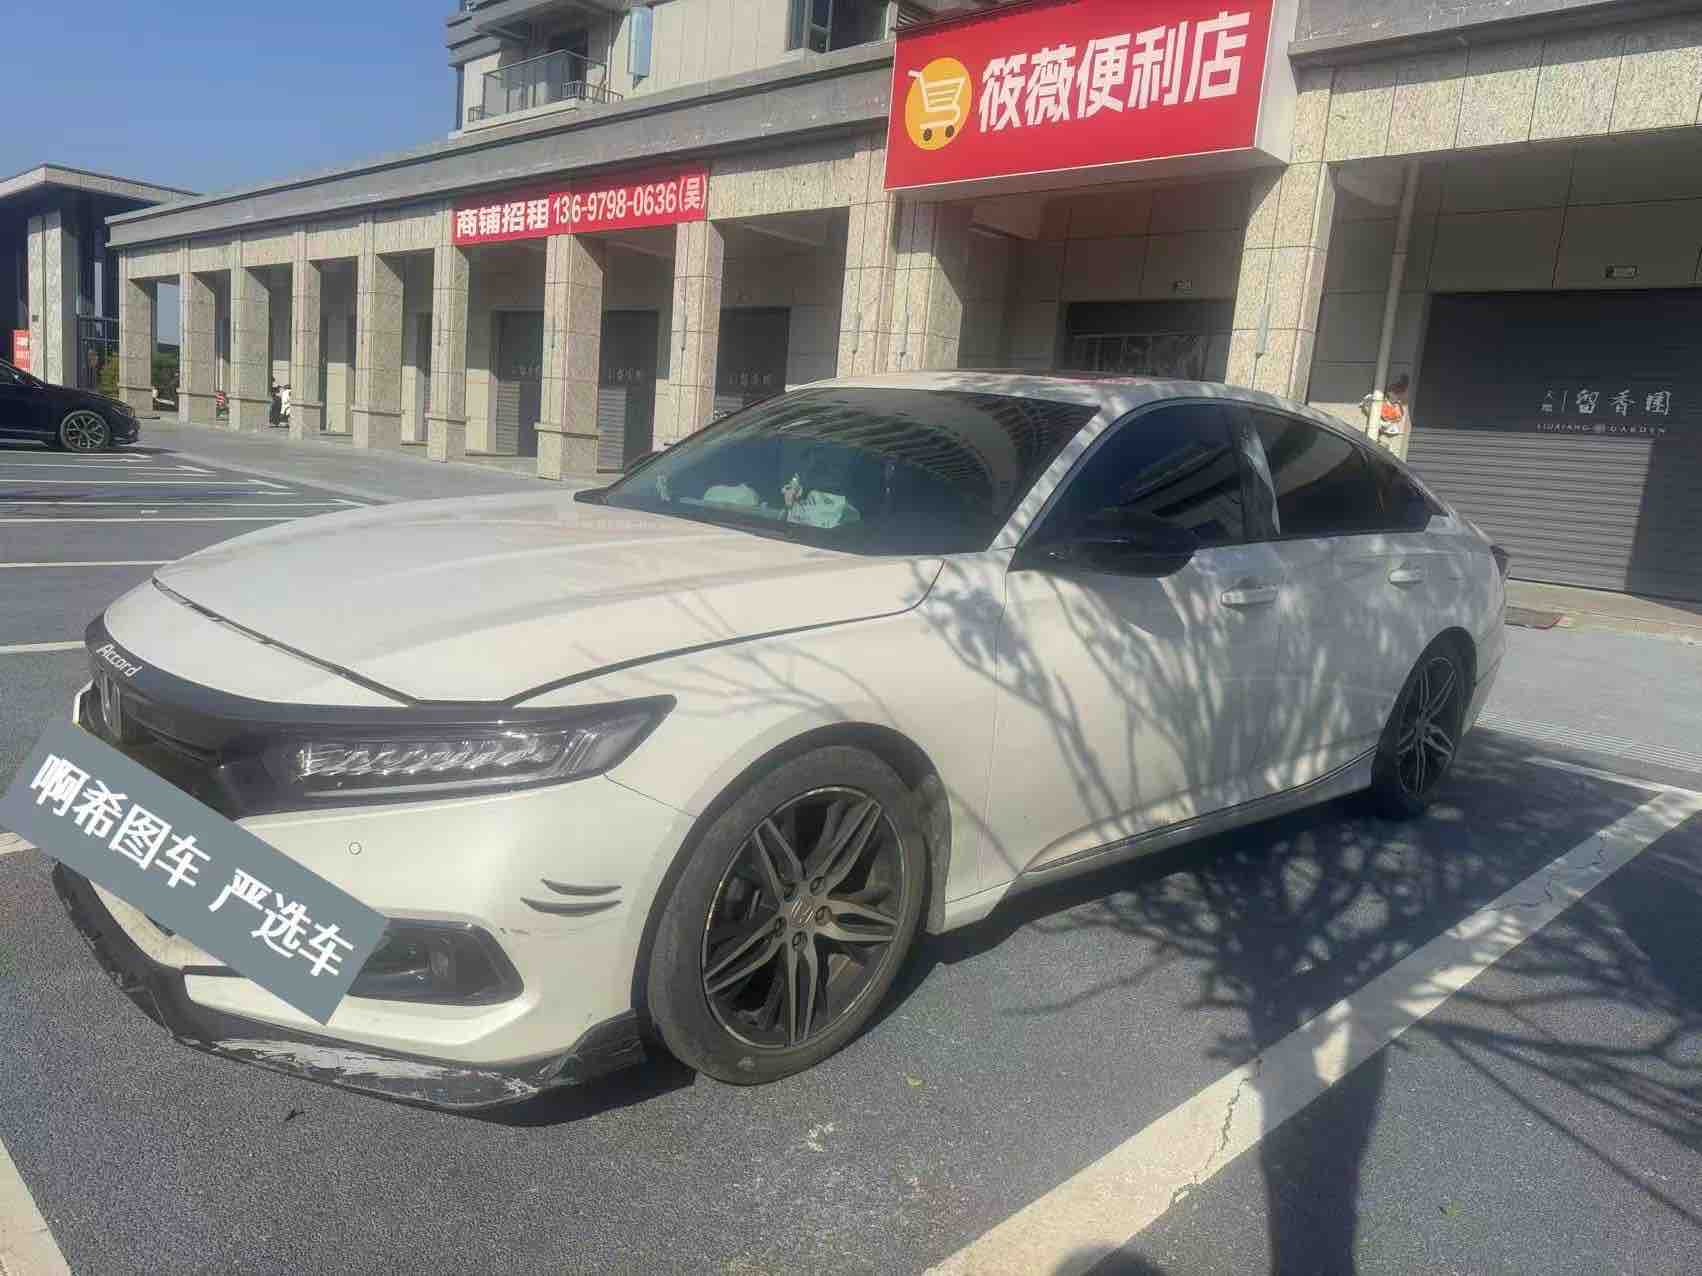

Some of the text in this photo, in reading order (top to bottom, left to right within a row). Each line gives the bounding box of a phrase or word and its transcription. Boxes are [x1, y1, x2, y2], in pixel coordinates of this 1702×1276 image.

[979, 11, 1251, 133] 筱薇便利店
[456, 198, 550, 238] 商铺招租
[96, 644, 143, 677] Accord
